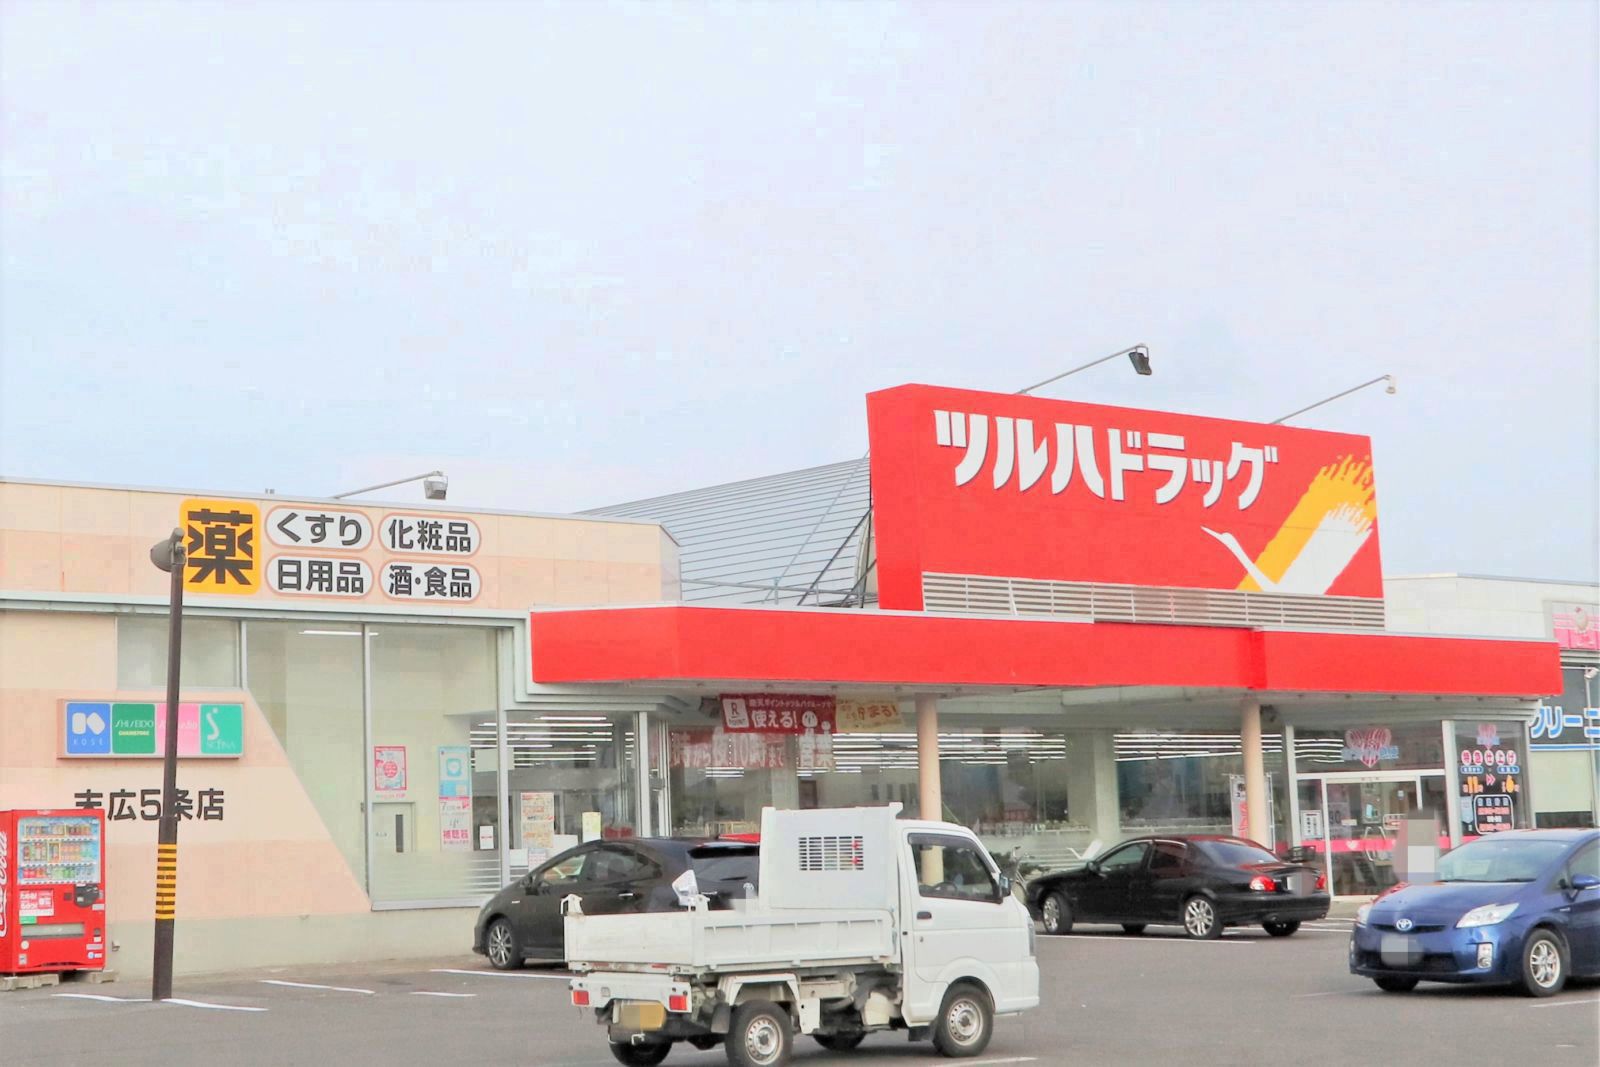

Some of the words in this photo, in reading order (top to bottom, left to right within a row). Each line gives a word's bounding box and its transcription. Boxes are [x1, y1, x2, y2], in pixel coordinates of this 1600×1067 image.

[934, 409, 1279, 511] ツルハドラッグ
[277, 512, 363, 546] くすり
[388, 519, 472, 553] 化粧品
[187, 508, 253, 586] 薬
[277, 559, 365, 594] 日用品
[115, 719, 154, 728] SHISEIDO
[751, 710, 798, 728] 使える!
